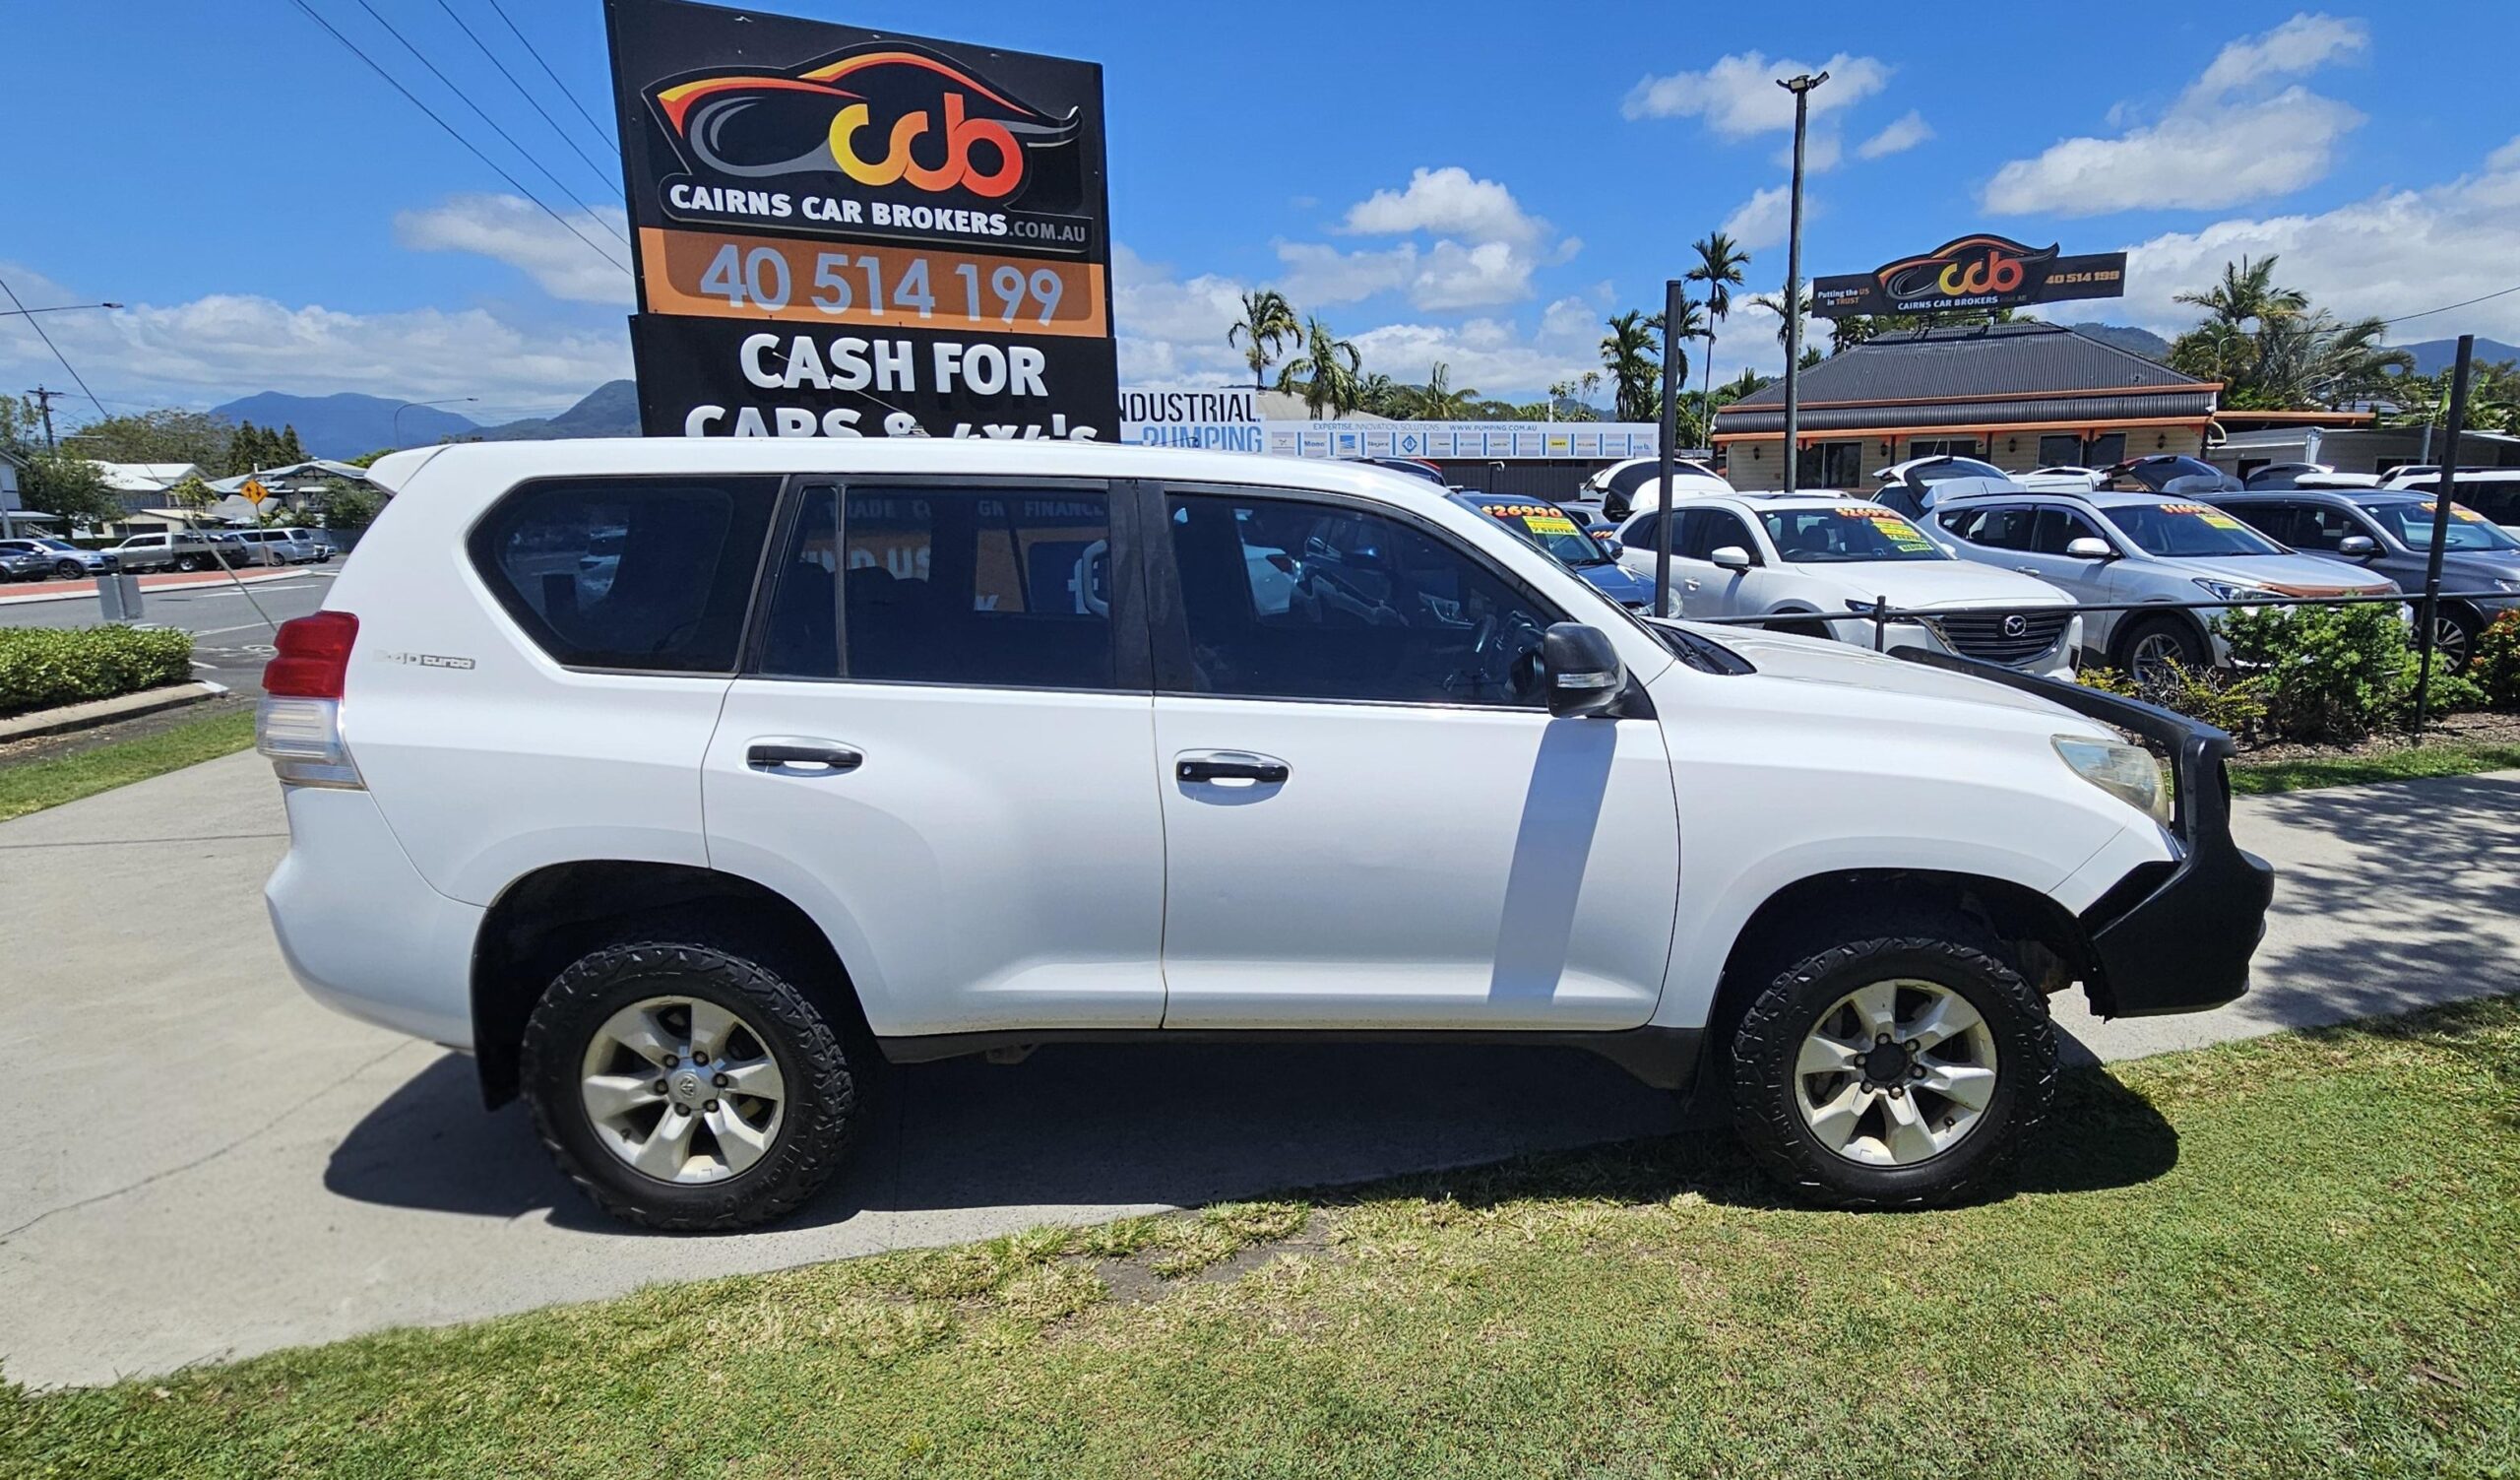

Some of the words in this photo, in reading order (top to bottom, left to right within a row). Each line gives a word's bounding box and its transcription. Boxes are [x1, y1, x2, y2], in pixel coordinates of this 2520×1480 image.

[669, 184, 792, 218] CAIRNS
[801, 196, 863, 224] CAR
[700, 243, 791, 311] 40
[810, 252, 935, 319] 514
[955, 263, 1063, 326] 199
[2045, 274, 2065, 285] 40
[2066, 273, 2092, 284] 514
[1817, 289, 1844, 298] Putting
[1858, 287, 1870, 295] US
[1827, 297, 1835, 306] in
[1898, 299, 1931, 310] CAIRNS
[1933, 298, 1952, 308] CAR
[740, 333, 915, 392] CASH
[933, 342, 1049, 397] FOR
[1480, 505, 1563, 518] $26990
